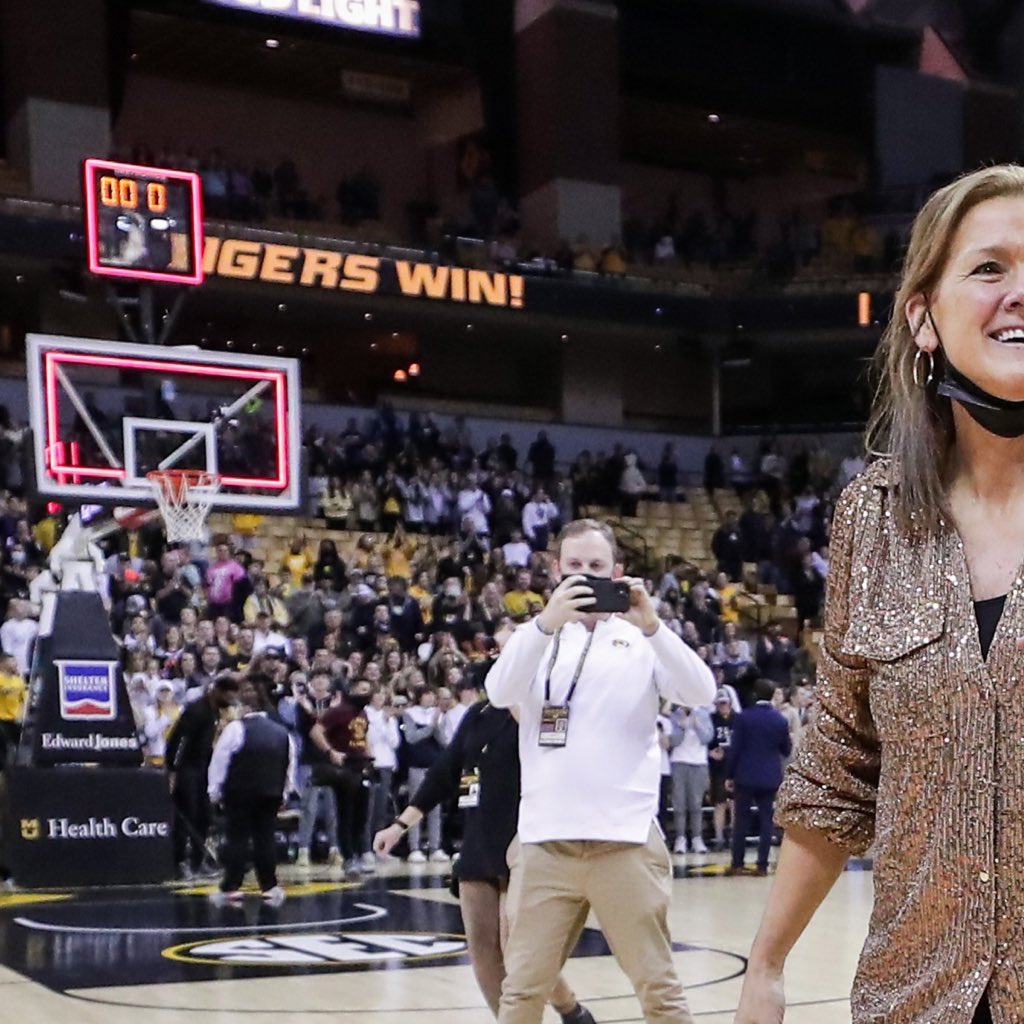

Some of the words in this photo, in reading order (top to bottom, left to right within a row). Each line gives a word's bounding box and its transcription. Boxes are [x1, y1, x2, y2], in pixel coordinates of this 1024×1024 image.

[396, 259, 526, 309] WIN!
[64, 675, 108, 685] SHELTER
[48, 817, 117, 838] Health
[121, 816, 168, 836] Care
[189, 934, 467, 962] SEC
